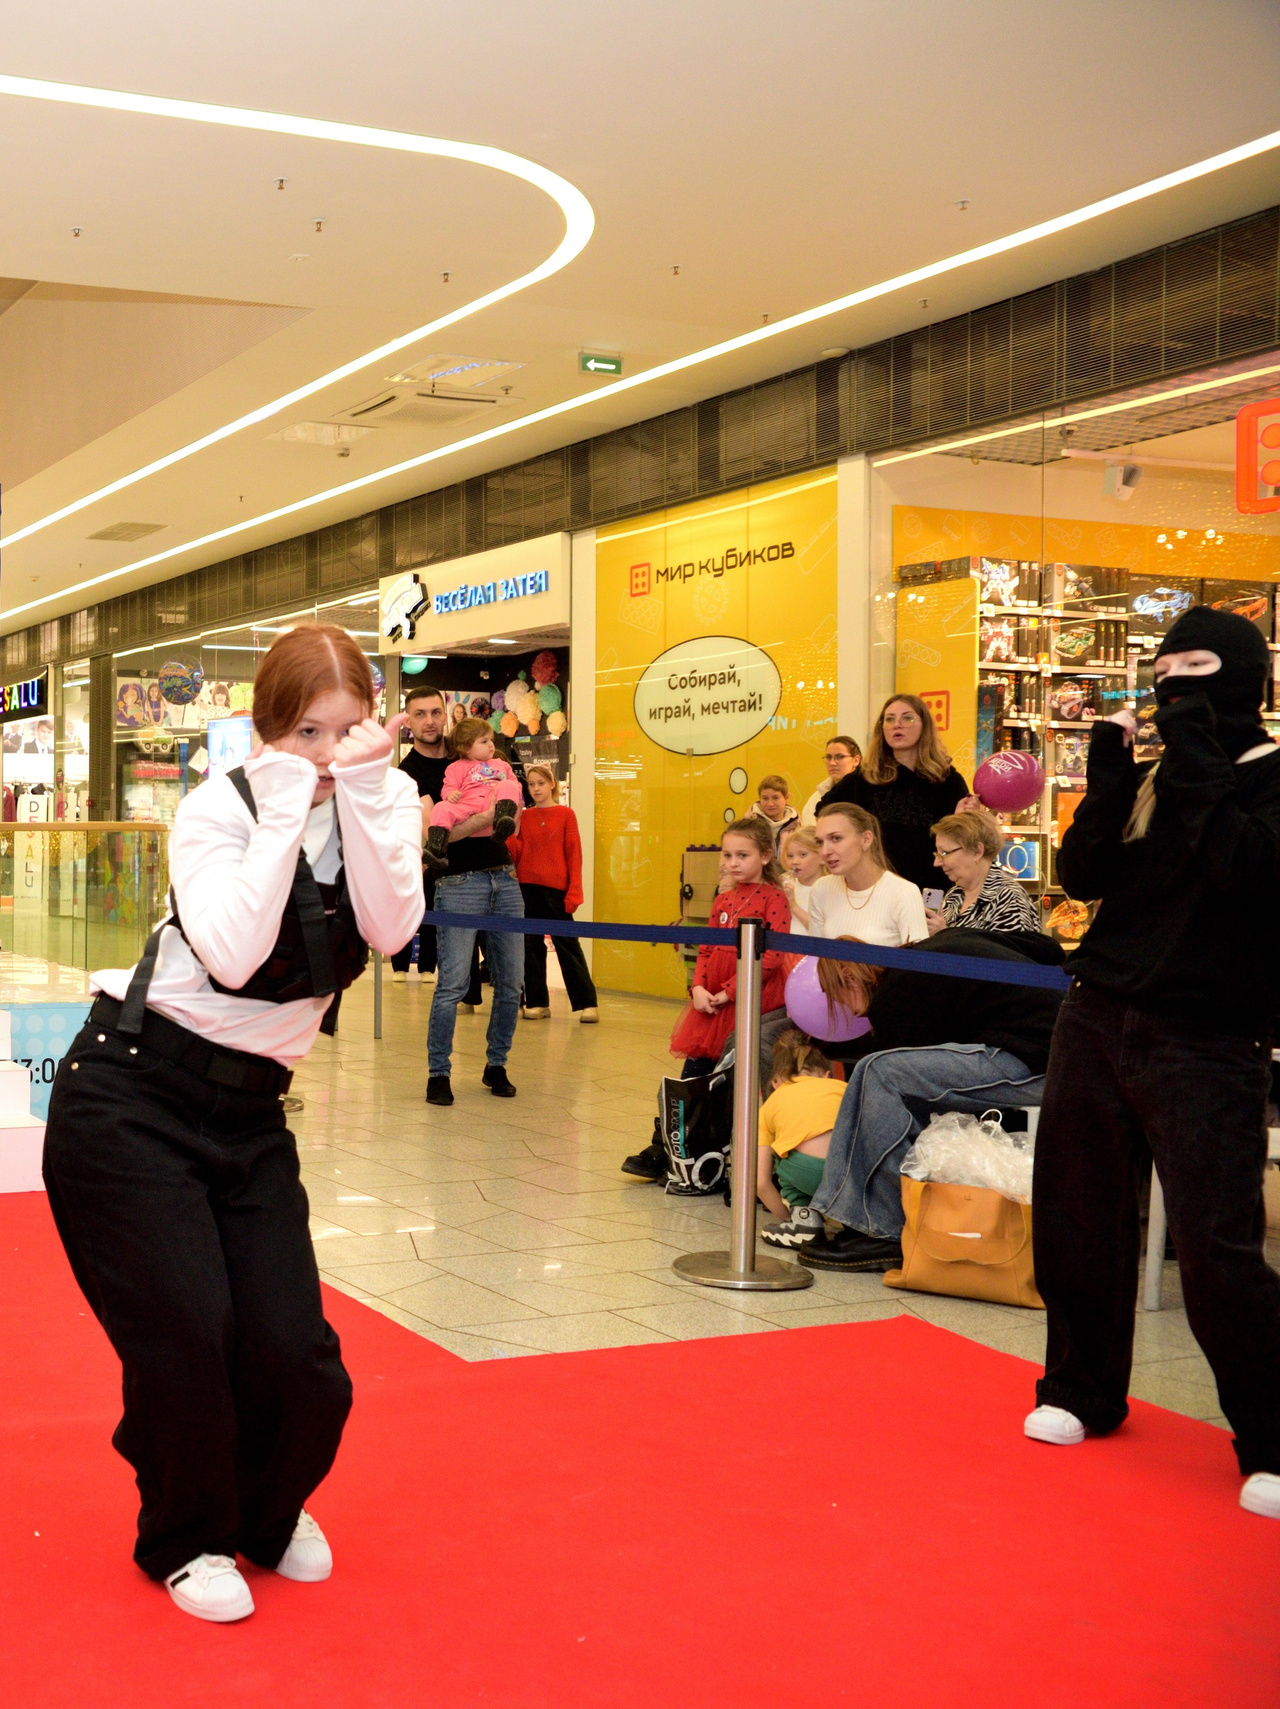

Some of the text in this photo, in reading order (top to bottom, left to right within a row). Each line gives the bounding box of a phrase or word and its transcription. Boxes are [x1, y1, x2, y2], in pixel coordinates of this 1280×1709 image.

[698, 541, 795, 578] кубиков
[433, 582, 497, 615] ВЕСЁЛАЯ
[498, 570, 549, 601] ЗАТЕЯ
[667, 664, 741, 691] Собирай,
[648, 691, 763, 723] играй, мечтай!
